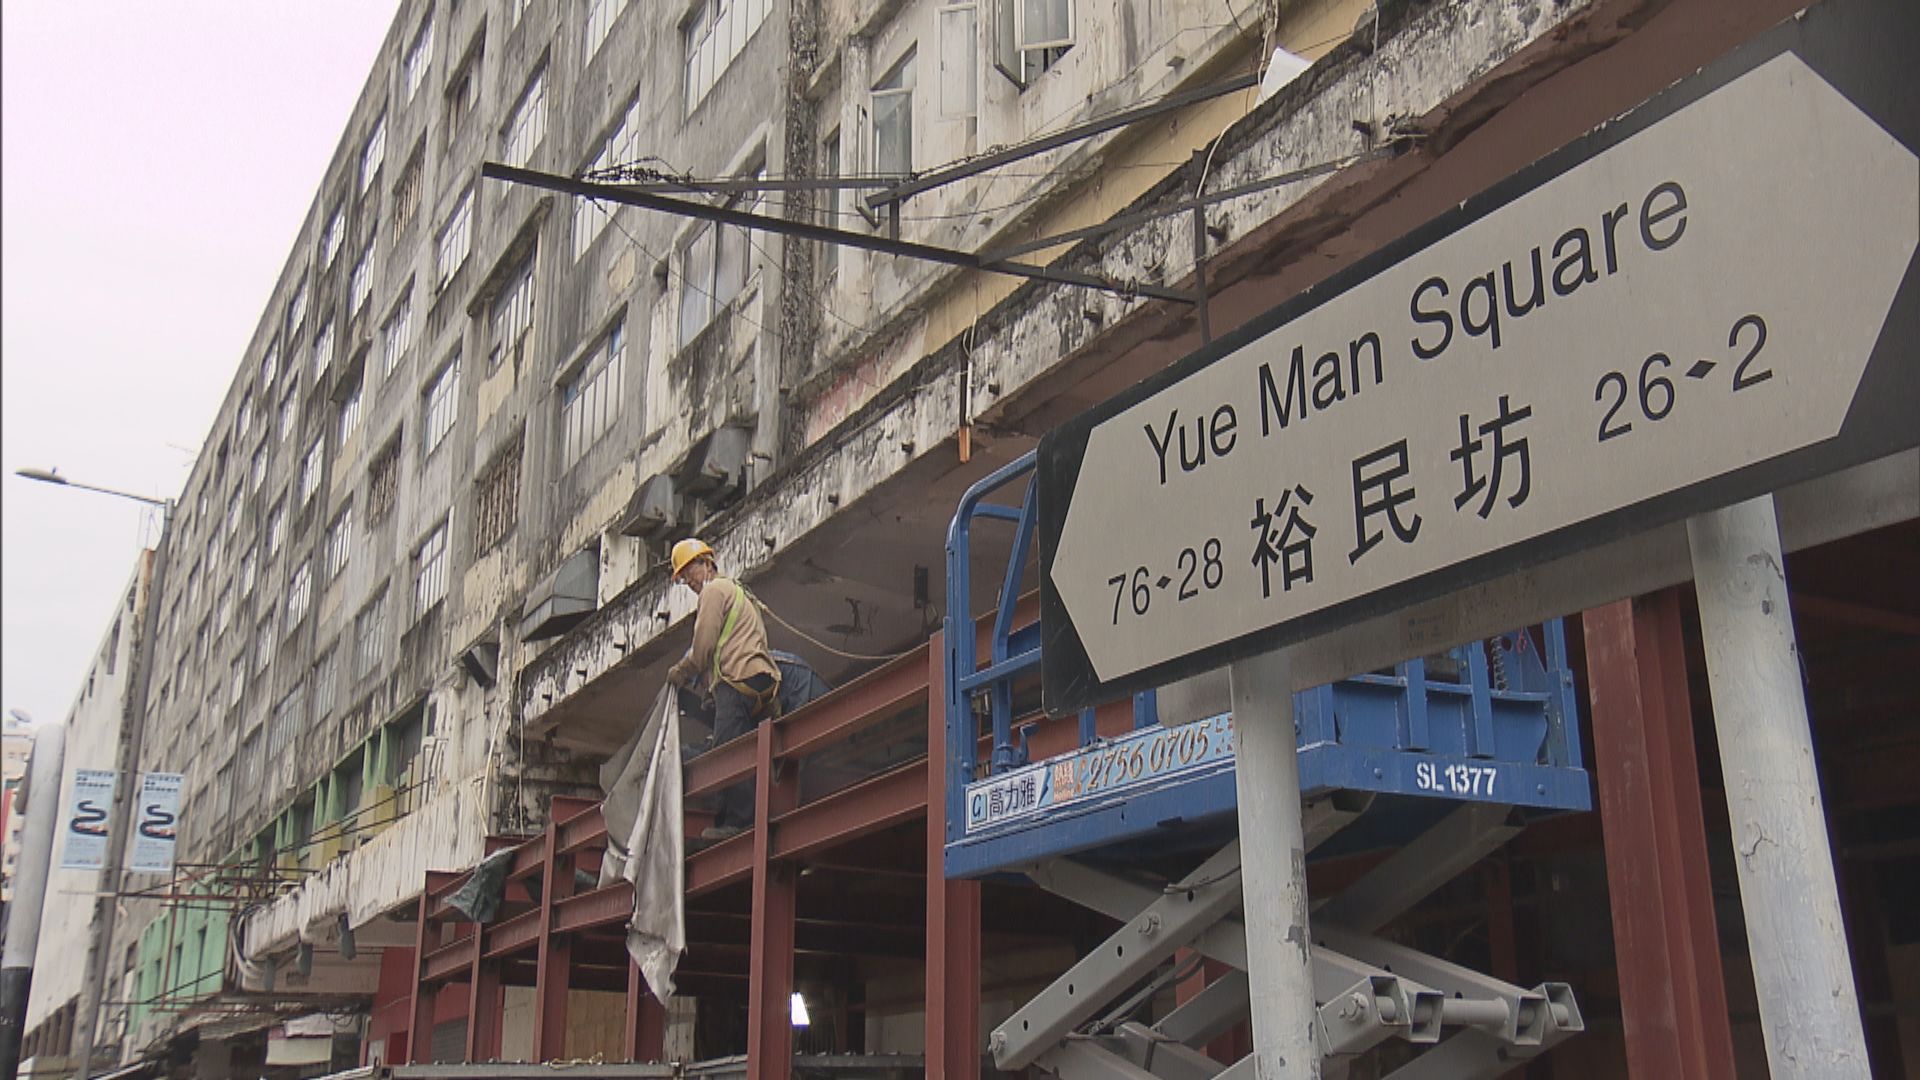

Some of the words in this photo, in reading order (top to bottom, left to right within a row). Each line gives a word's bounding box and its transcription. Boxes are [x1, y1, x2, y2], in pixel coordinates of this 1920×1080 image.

[1144, 403, 1238, 486] Yue
[1259, 331, 1384, 438] Man
[1411, 180, 1689, 360] Square
[1250, 395, 1532, 600] 裕民坊
[990, 777, 1036, 817] 高力雅
[1087, 741, 1145, 791] 2756
[1150, 720, 1211, 773] 0705
